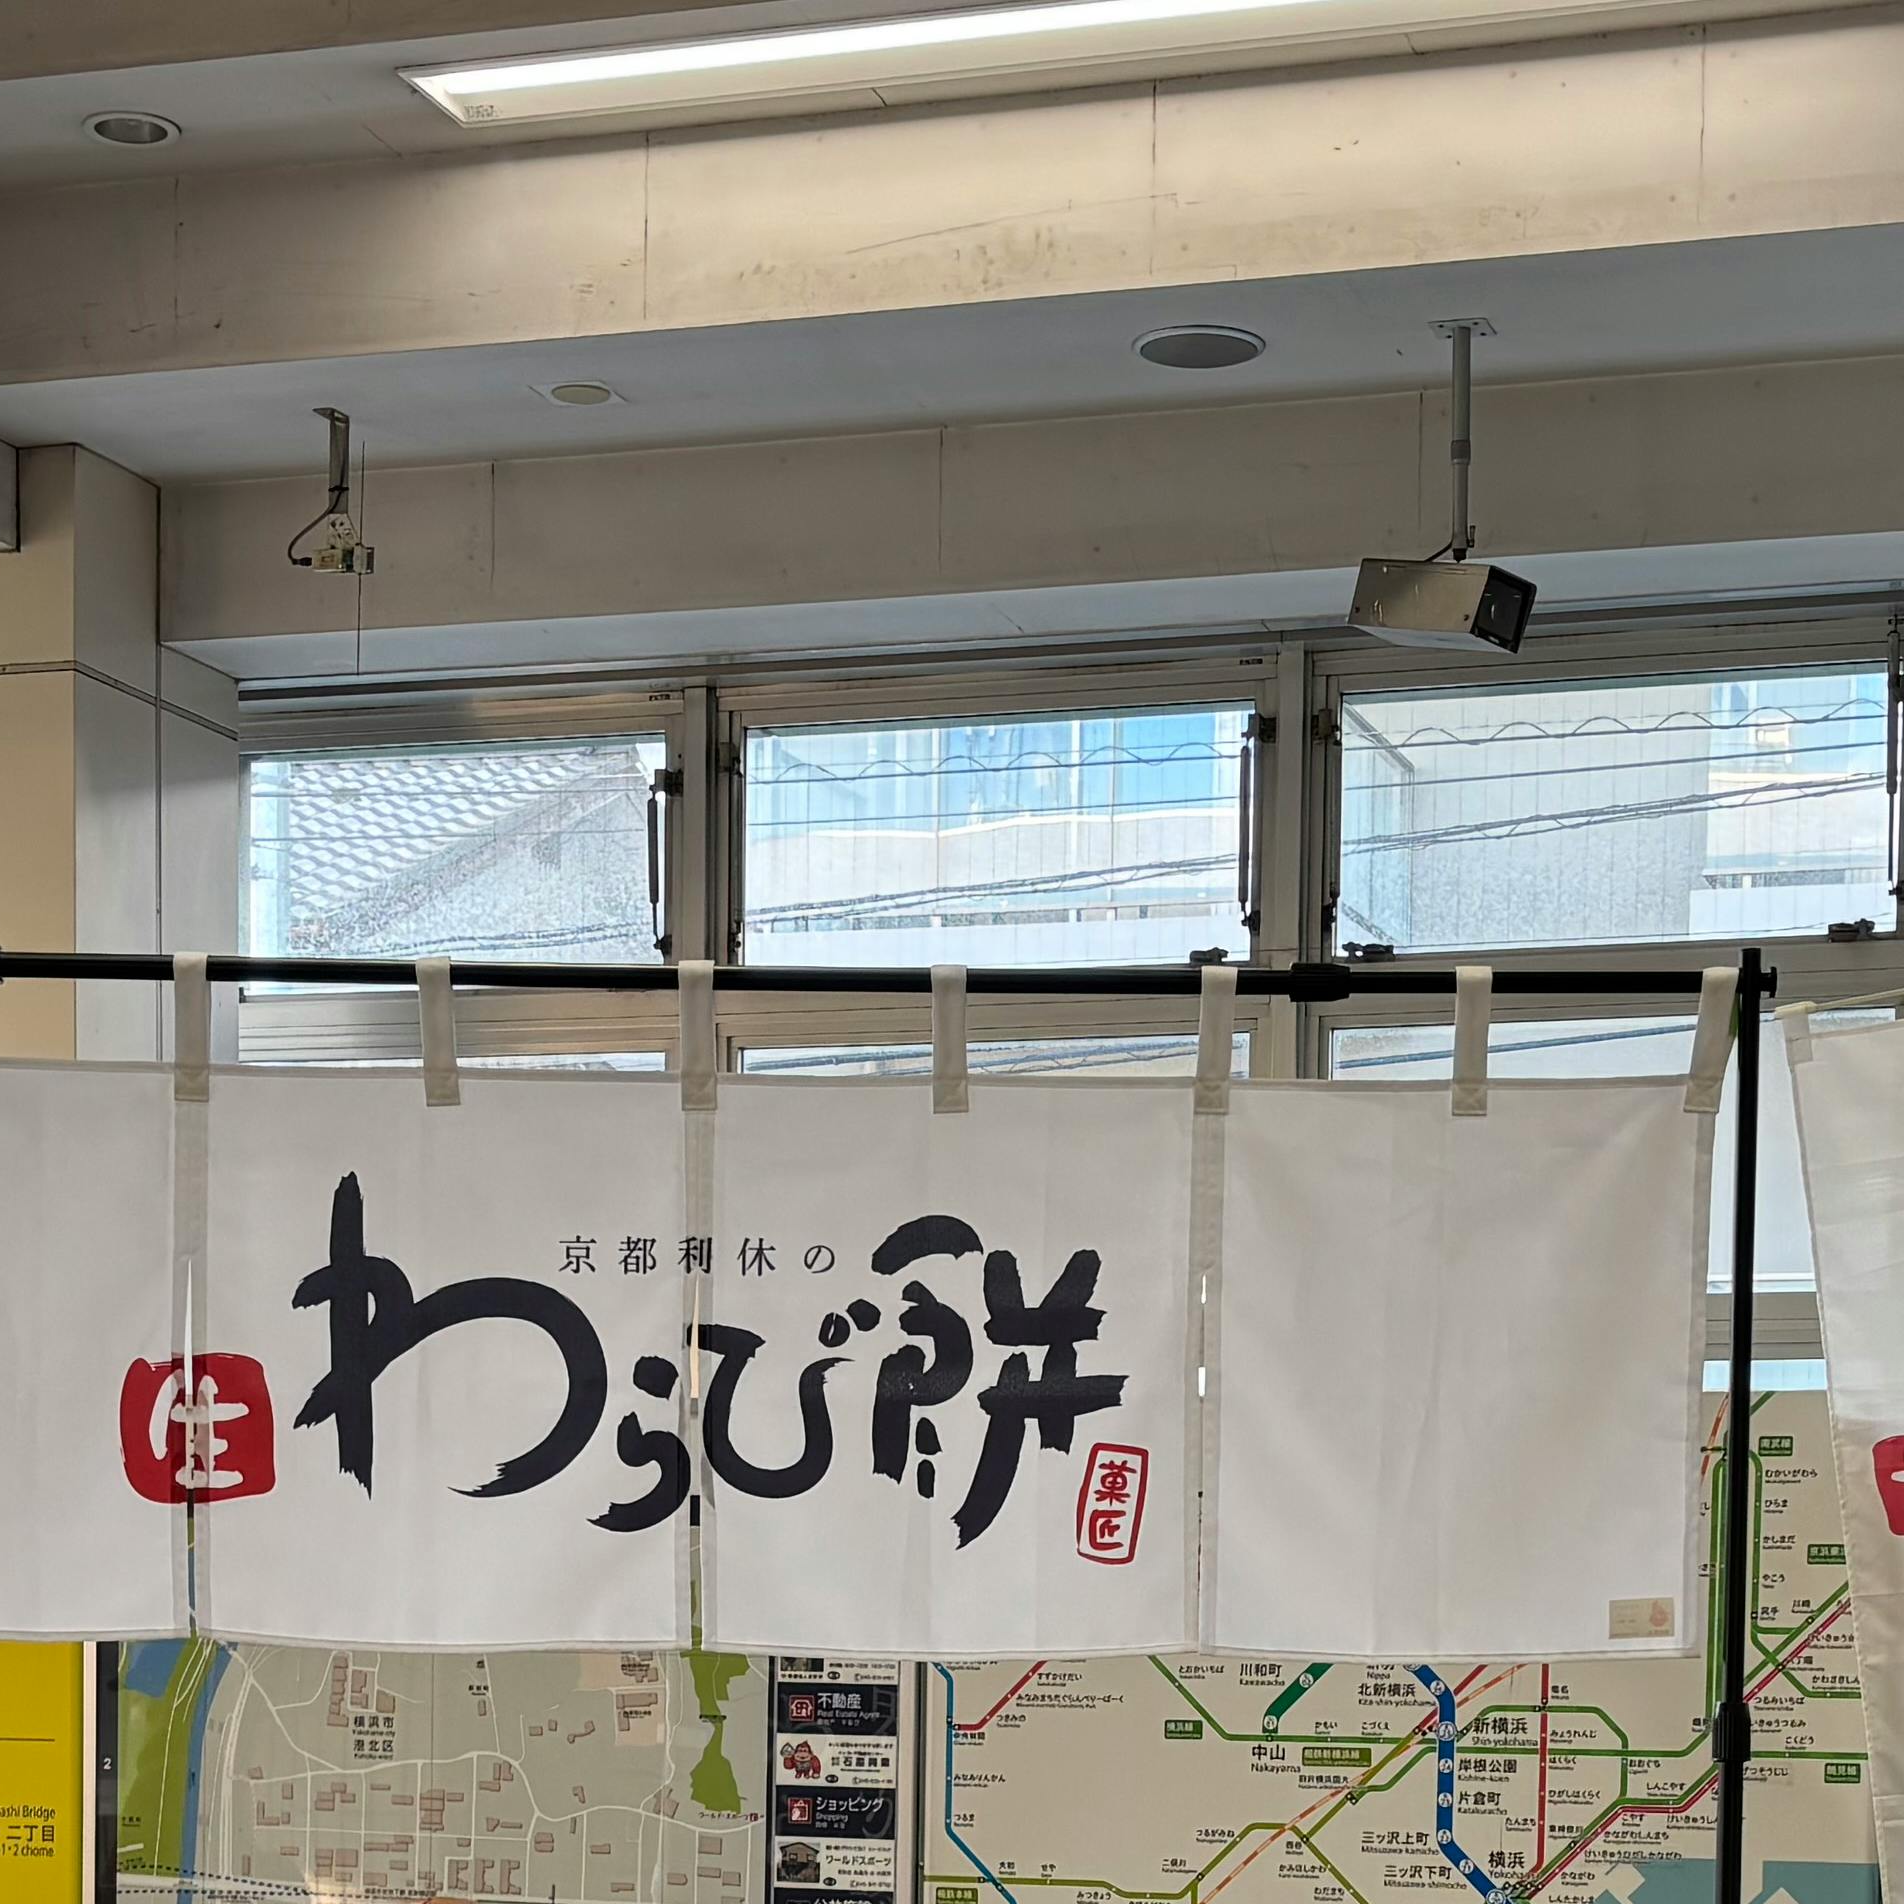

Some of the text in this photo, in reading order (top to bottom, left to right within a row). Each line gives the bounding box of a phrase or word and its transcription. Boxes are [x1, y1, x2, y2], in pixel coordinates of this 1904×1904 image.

[558, 1232, 837, 1279] 京都利休の
[292, 1169, 1128, 1550] わらび餅
[1239, 1663, 1283, 1678] 川和町
[1358, 1683, 1417, 1698] 北新横浜
[817, 1693, 862, 1710] 不動産
[353, 1715, 396, 1729] 横浜市
[1472, 1717, 1529, 1736] 新横浜
[1252, 1744, 1286, 1761] 中山
[1458, 1759, 1518, 1774] 岸根公園
[816, 1796, 885, 1814] ショッピング
[1458, 1791, 1502, 1806] 片倉町
[22, 1804, 56, 1822] Bridge
[1488, 1851, 1526, 1869] 横浜
